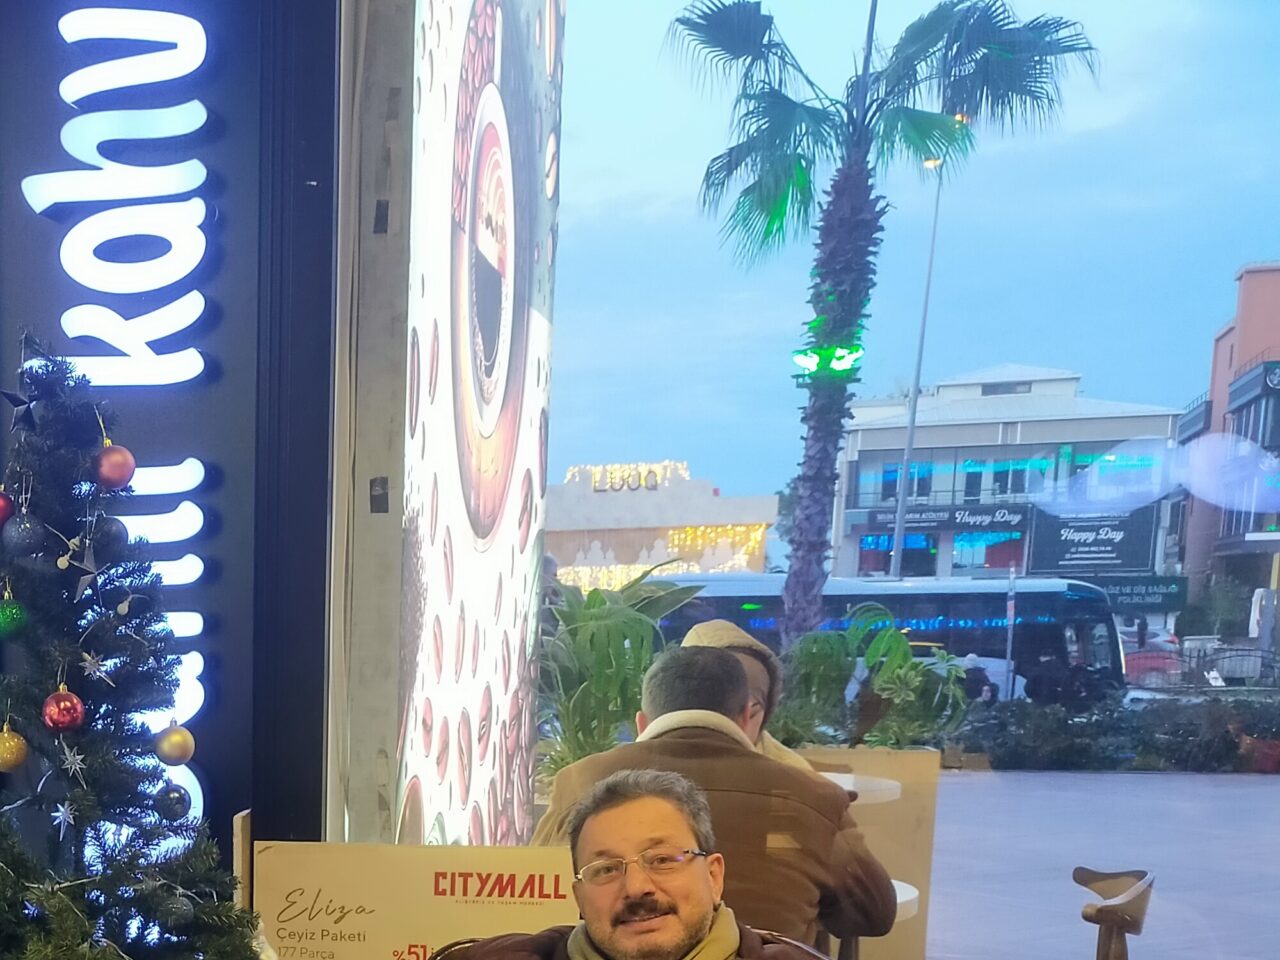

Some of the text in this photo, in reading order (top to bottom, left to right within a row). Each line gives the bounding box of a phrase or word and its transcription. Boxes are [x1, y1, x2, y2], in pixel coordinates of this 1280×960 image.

[954, 509, 992, 526] Happy
[993, 509, 1023, 526] Day
[1060, 527, 1125, 543] Happy Day
[434, 872, 567, 899] CITYMALL
[276, 888, 376, 925] Eliza
[276, 927, 367, 943] Çeyiz Paketi
[277, 946, 335, 960] 177 Parça
